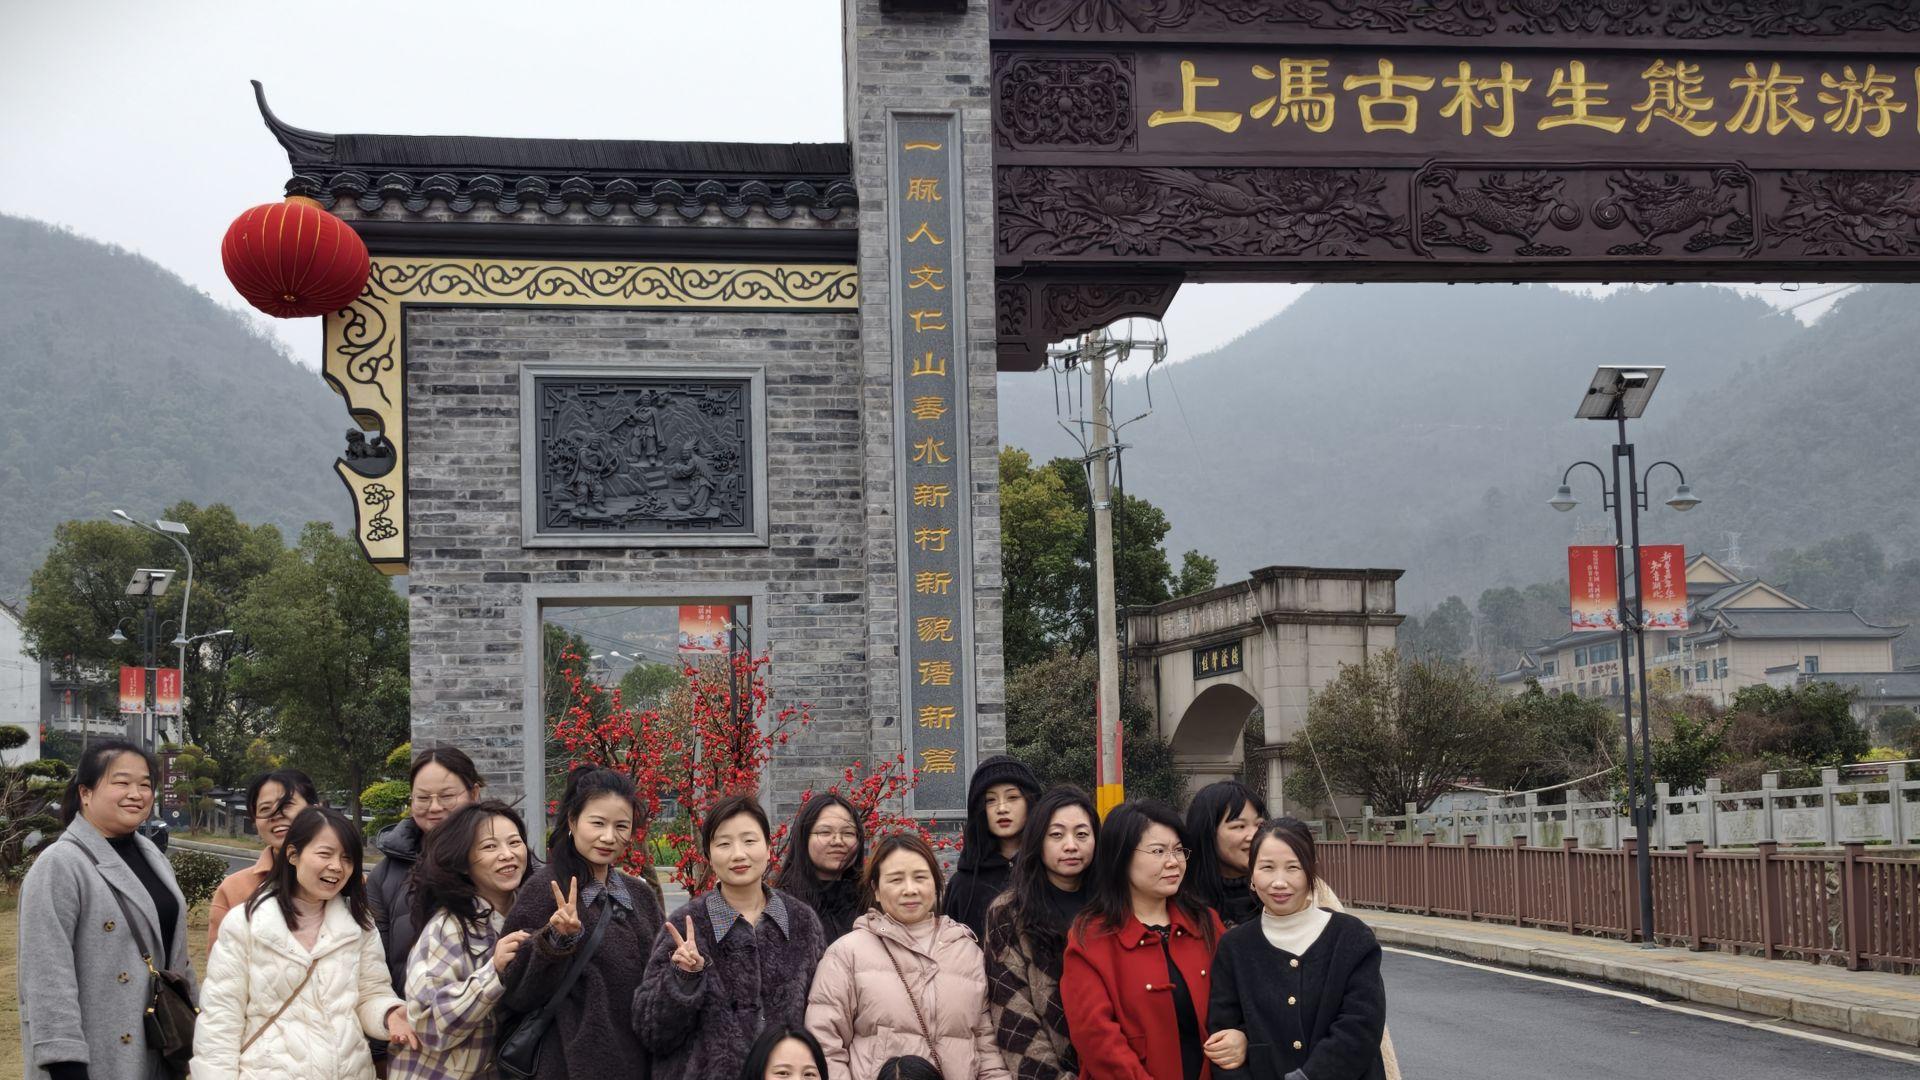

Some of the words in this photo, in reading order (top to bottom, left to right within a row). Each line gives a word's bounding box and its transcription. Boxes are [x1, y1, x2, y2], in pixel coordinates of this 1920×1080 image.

[1147, 57, 1920, 137] 上馮古村生態旅游
